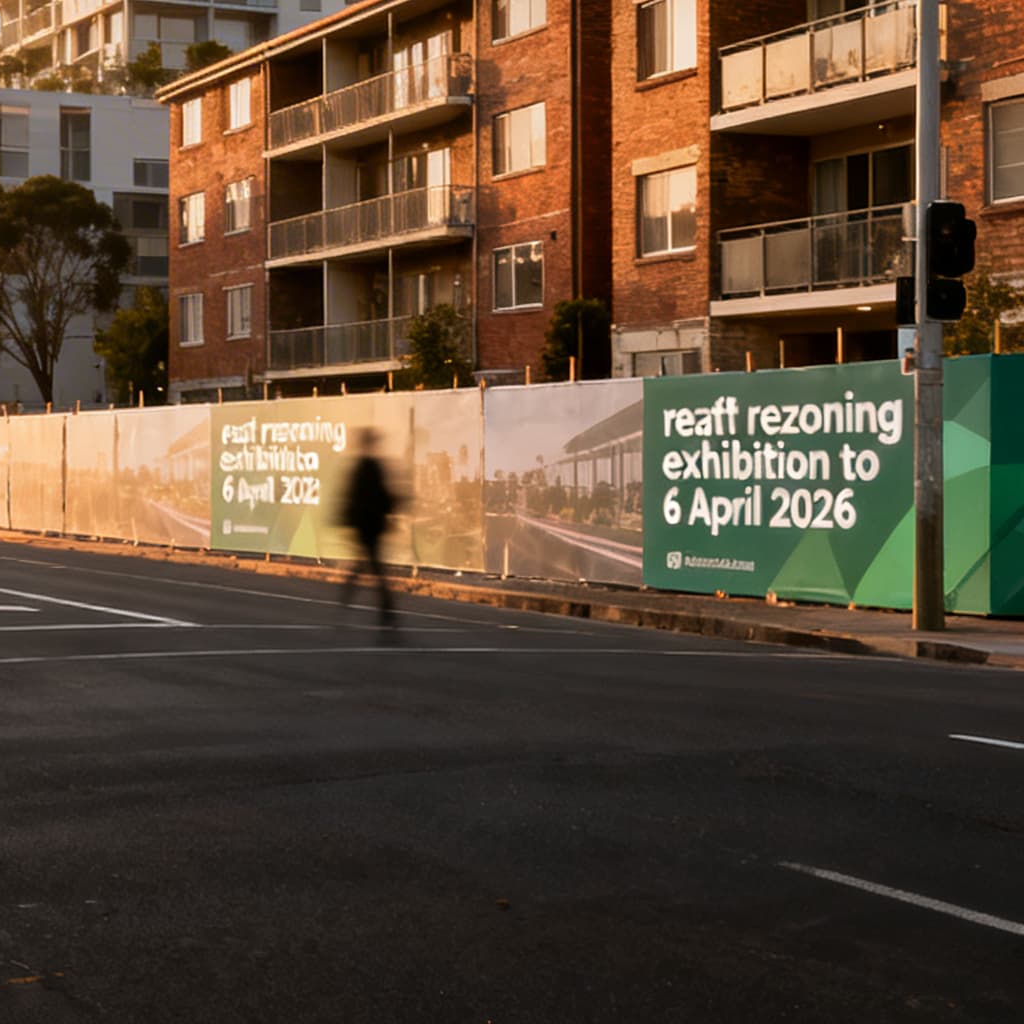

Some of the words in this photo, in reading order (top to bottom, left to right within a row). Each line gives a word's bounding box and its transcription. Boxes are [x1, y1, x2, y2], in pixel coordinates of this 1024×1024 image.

[747, 390, 903, 445] rezoning
[662, 439, 831, 482] exhibition
[839, 442, 881, 482] to
[662, 486, 682, 525] 6
[687, 484, 762, 536] April
[768, 487, 857, 530] 2026
